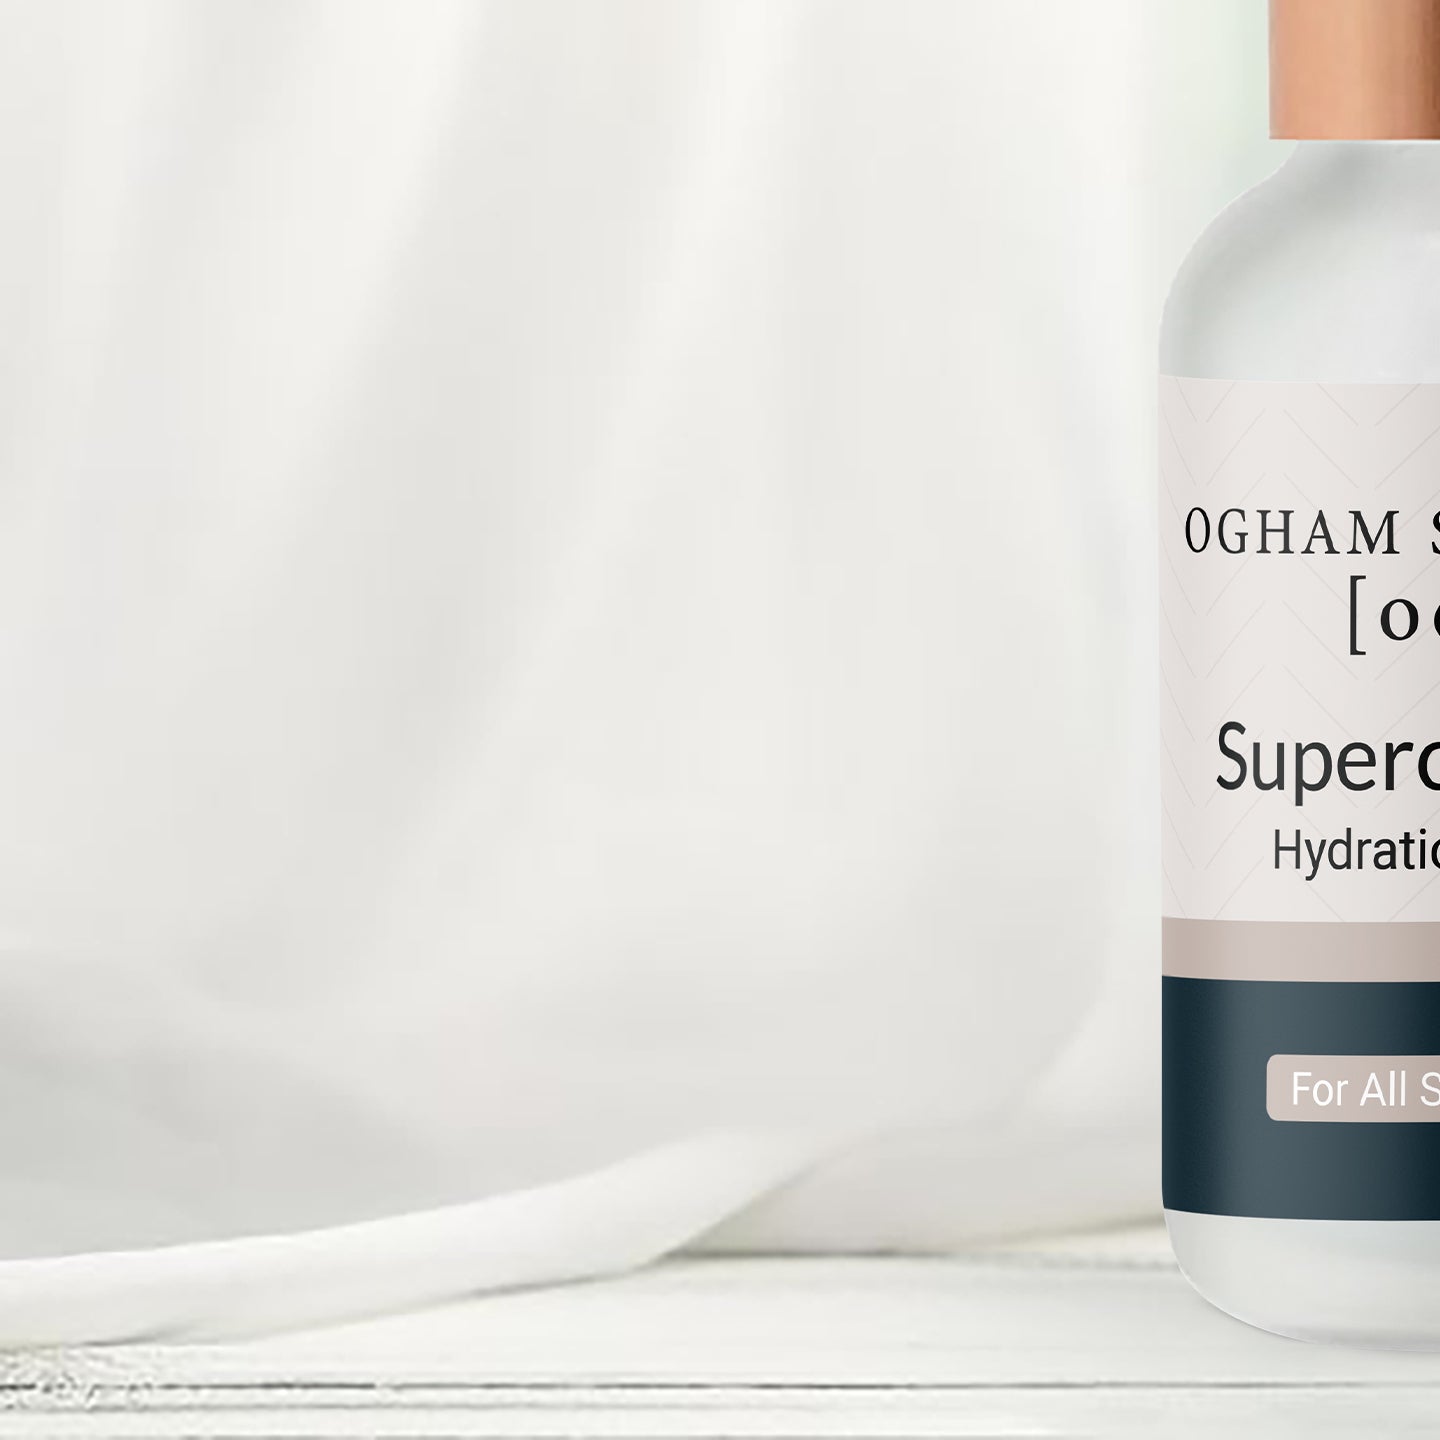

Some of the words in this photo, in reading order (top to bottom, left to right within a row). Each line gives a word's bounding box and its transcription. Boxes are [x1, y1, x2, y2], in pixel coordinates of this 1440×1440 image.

[1184, 506, 1400, 556] OGHAM
[1291, 1070, 1349, 1107] For
[1359, 1070, 1406, 1107] All
